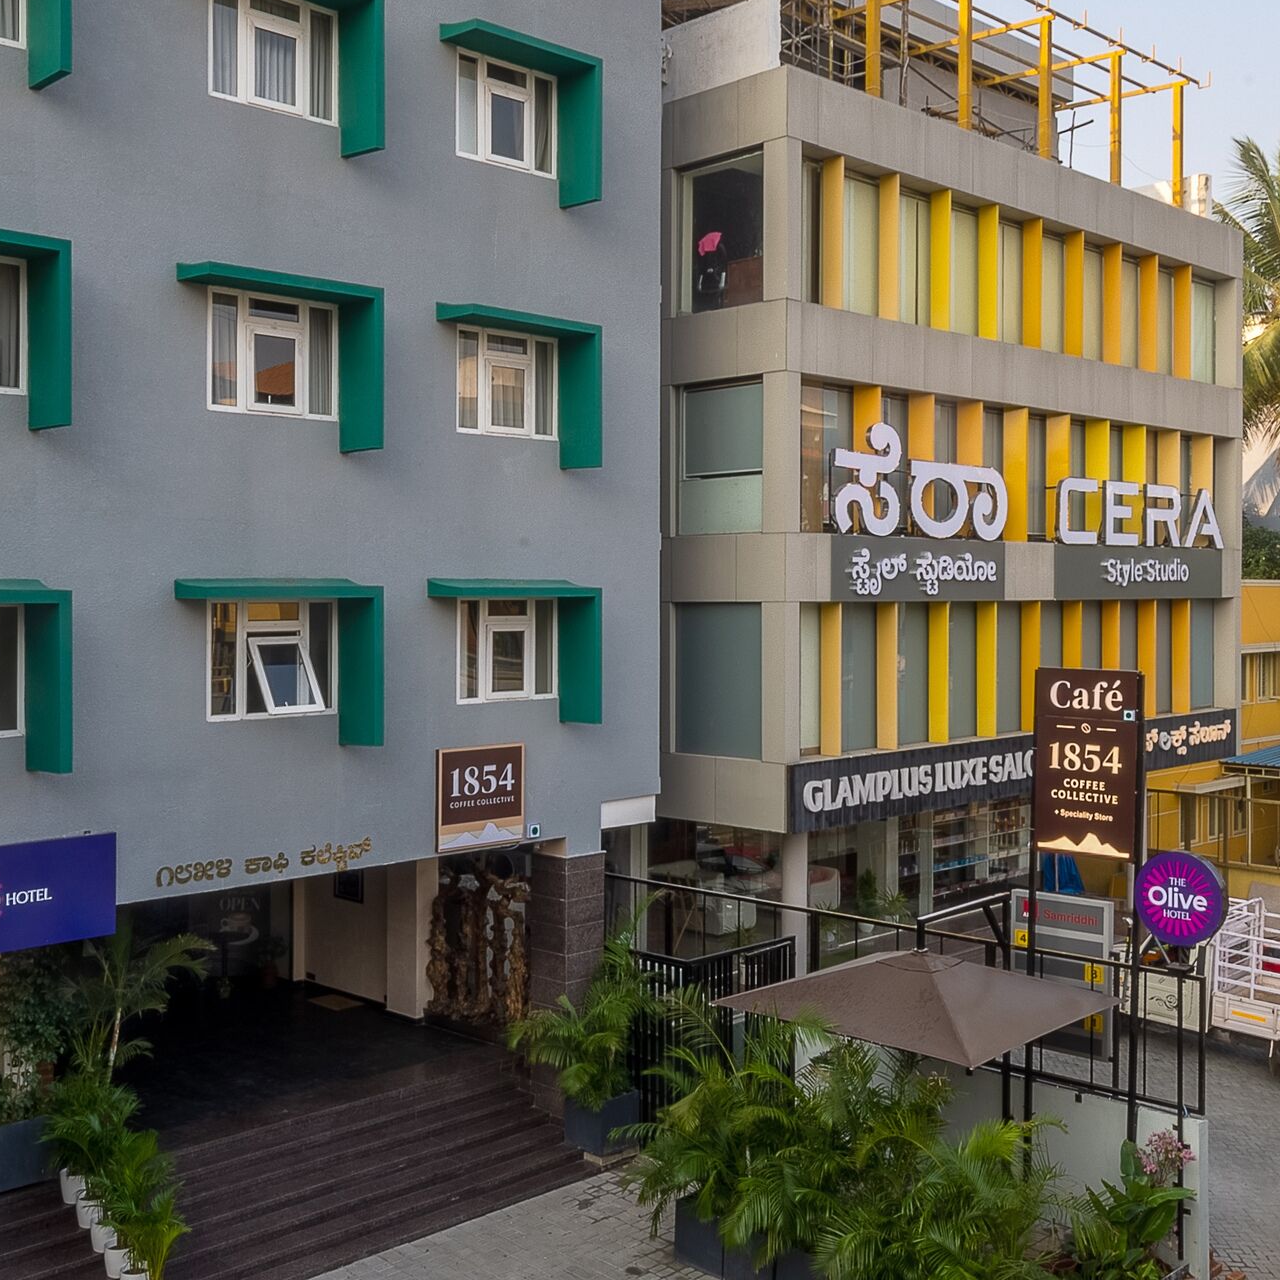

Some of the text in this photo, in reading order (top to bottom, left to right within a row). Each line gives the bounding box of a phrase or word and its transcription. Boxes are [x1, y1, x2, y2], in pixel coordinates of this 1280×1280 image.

[834, 422, 1008, 542] ಸೆರಾ
[1057, 477, 1225, 550] CERA
[1107, 558, 1190, 587] Style Studio
[1049, 679, 1124, 712] Café
[1048, 741, 1123, 775] 1854
[449, 762, 516, 798] 1854
[803, 763, 932, 813] GLAMPLUS
[934, 756, 988, 793] LUXE
[1063, 778, 1106, 791] COFFEE
[449, 795, 515, 809] COFFEE COLLECTIVE
[1050, 789, 1119, 805] COLLECTIVE
[1060, 808, 1114, 822] Speciality Store
[1168, 876, 1187, 888] THE
[6, 887, 53, 907] HOTEL
[219, 894, 261, 912] OPEN
[1148, 886, 1208, 912] Olive
[1043, 908, 1098, 927] Samriddhi
[1163, 909, 1192, 921] HOTEL
[1019, 933, 1027, 943] 4
